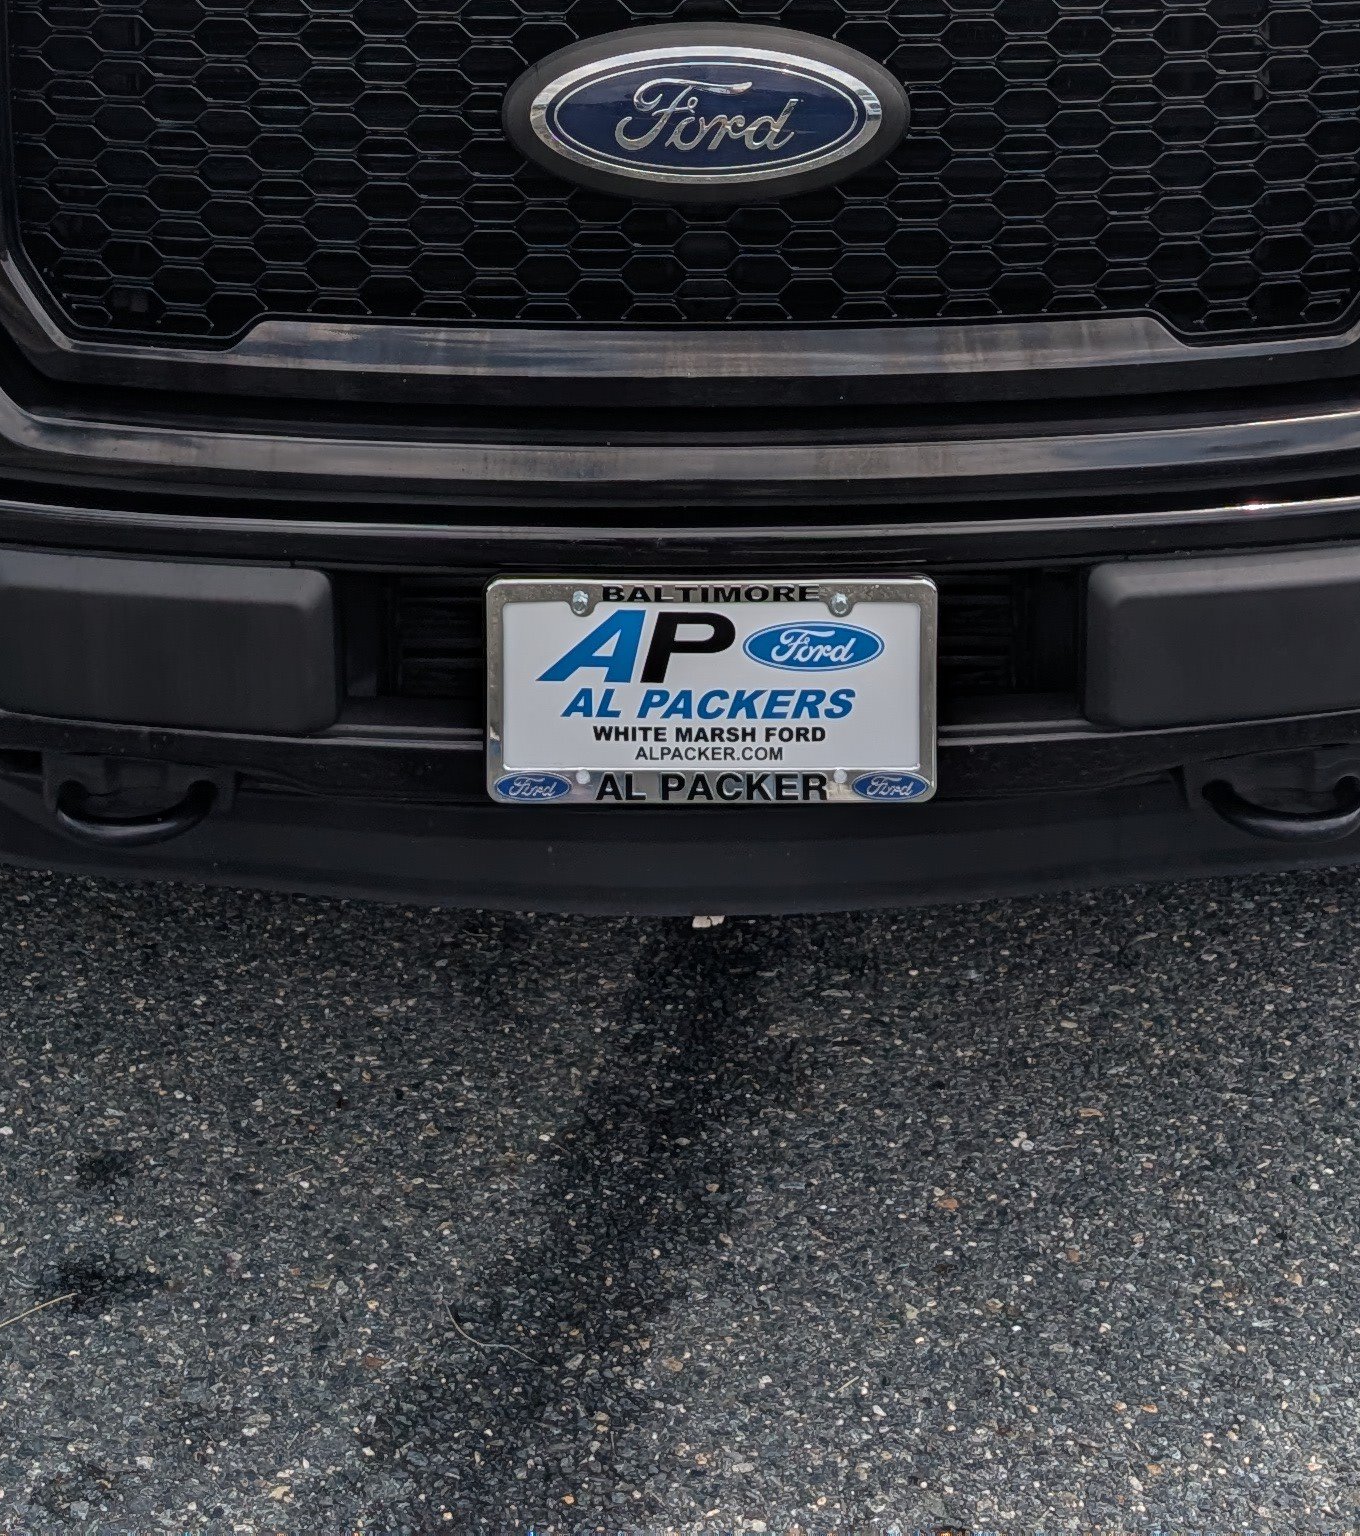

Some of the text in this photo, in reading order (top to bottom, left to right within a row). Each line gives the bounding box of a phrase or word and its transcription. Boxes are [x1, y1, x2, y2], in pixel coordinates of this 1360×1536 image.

[613, 77, 800, 152] Ford
[601, 584, 821, 603] BALTIMORE
[535, 609, 858, 684] AP Ford
[561, 688, 857, 720] AL PACKERS
[592, 725, 827, 743] WHITE MARSH FORD
[634, 746, 784, 762] ALPACKER.COM
[507, 771, 915, 802] Ford AL PACKER Ford
